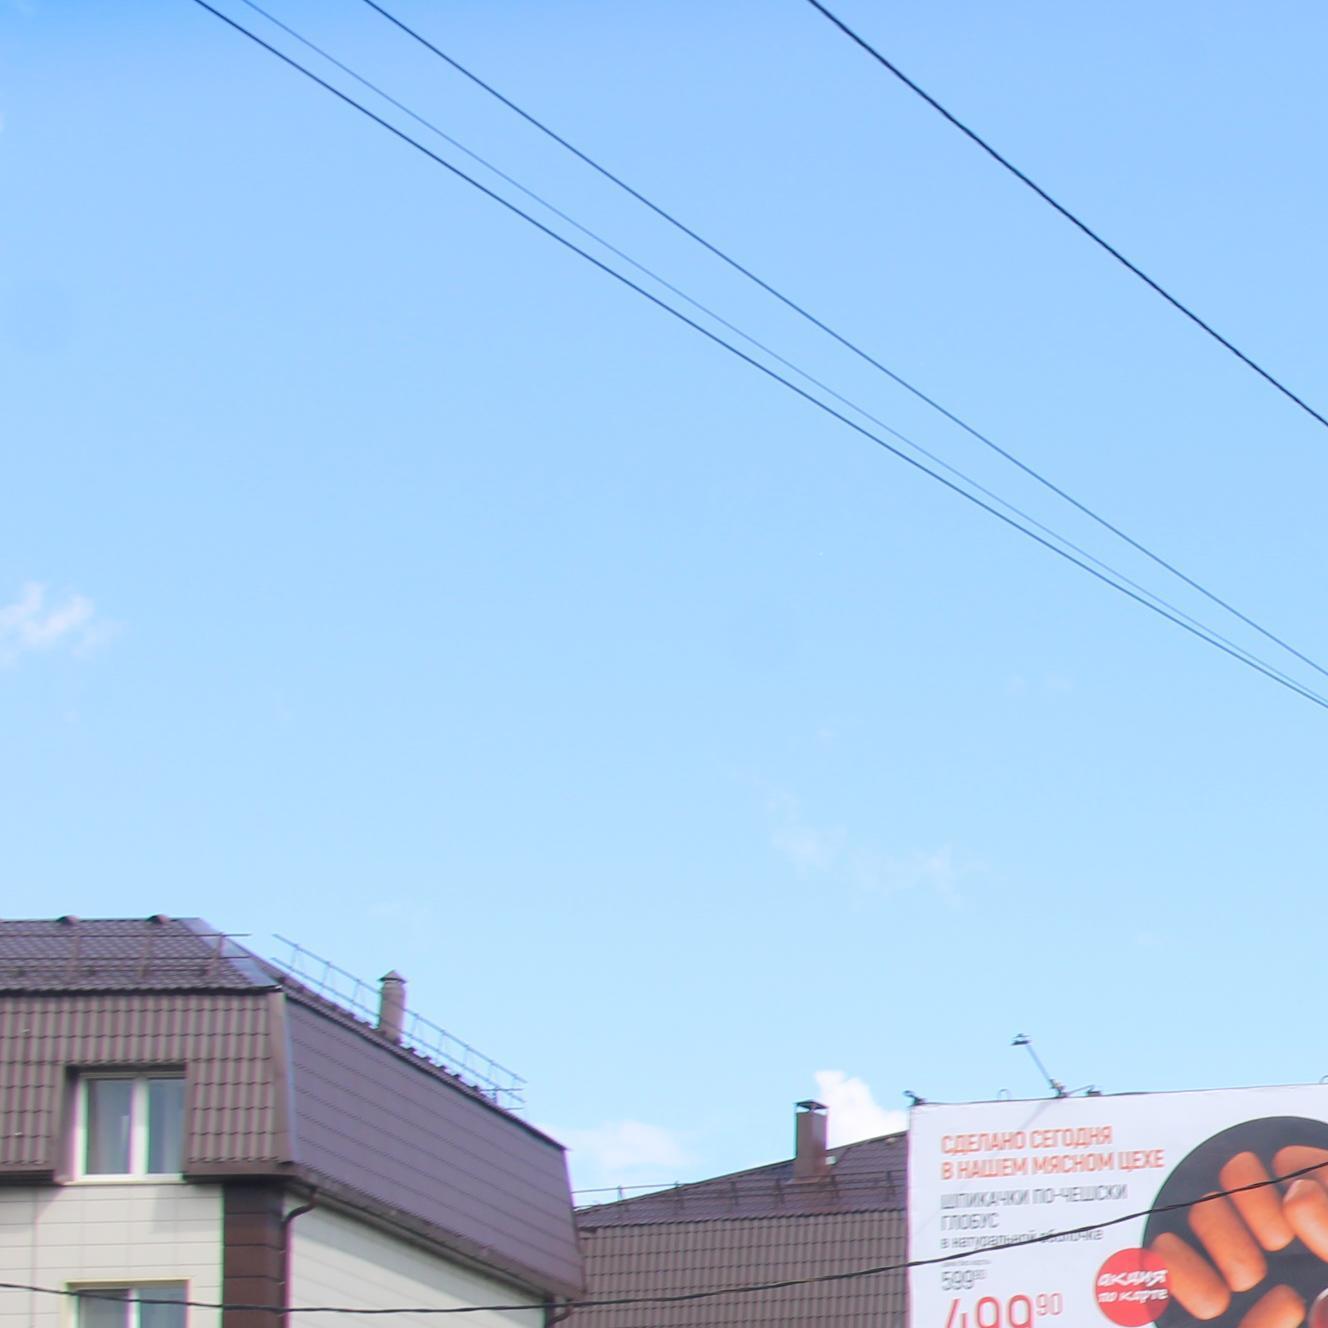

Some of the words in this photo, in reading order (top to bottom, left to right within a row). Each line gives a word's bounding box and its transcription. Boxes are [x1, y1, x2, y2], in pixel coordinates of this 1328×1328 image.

[941, 1131, 1025, 1155] СДЕЛАНО
[1030, 1126, 1113, 1149] СЕГОДНЯ
[941, 1161, 955, 1180] В
[957, 1156, 1028, 1179] НАШЕМ
[1032, 1152, 1114, 1175] МЯСНОМ
[1118, 1149, 1165, 1173] ЦЕХЕ
[941, 1189, 1031, 1210] ШПИКАЧКИ
[1032, 1184, 1128, 1204] ПО-ЧЕШСКИ
[941, 1212, 1000, 1230] ГЛОБУС
[941, 1270, 974, 1291] 599
[1036, 1292, 1063, 1316] 90
